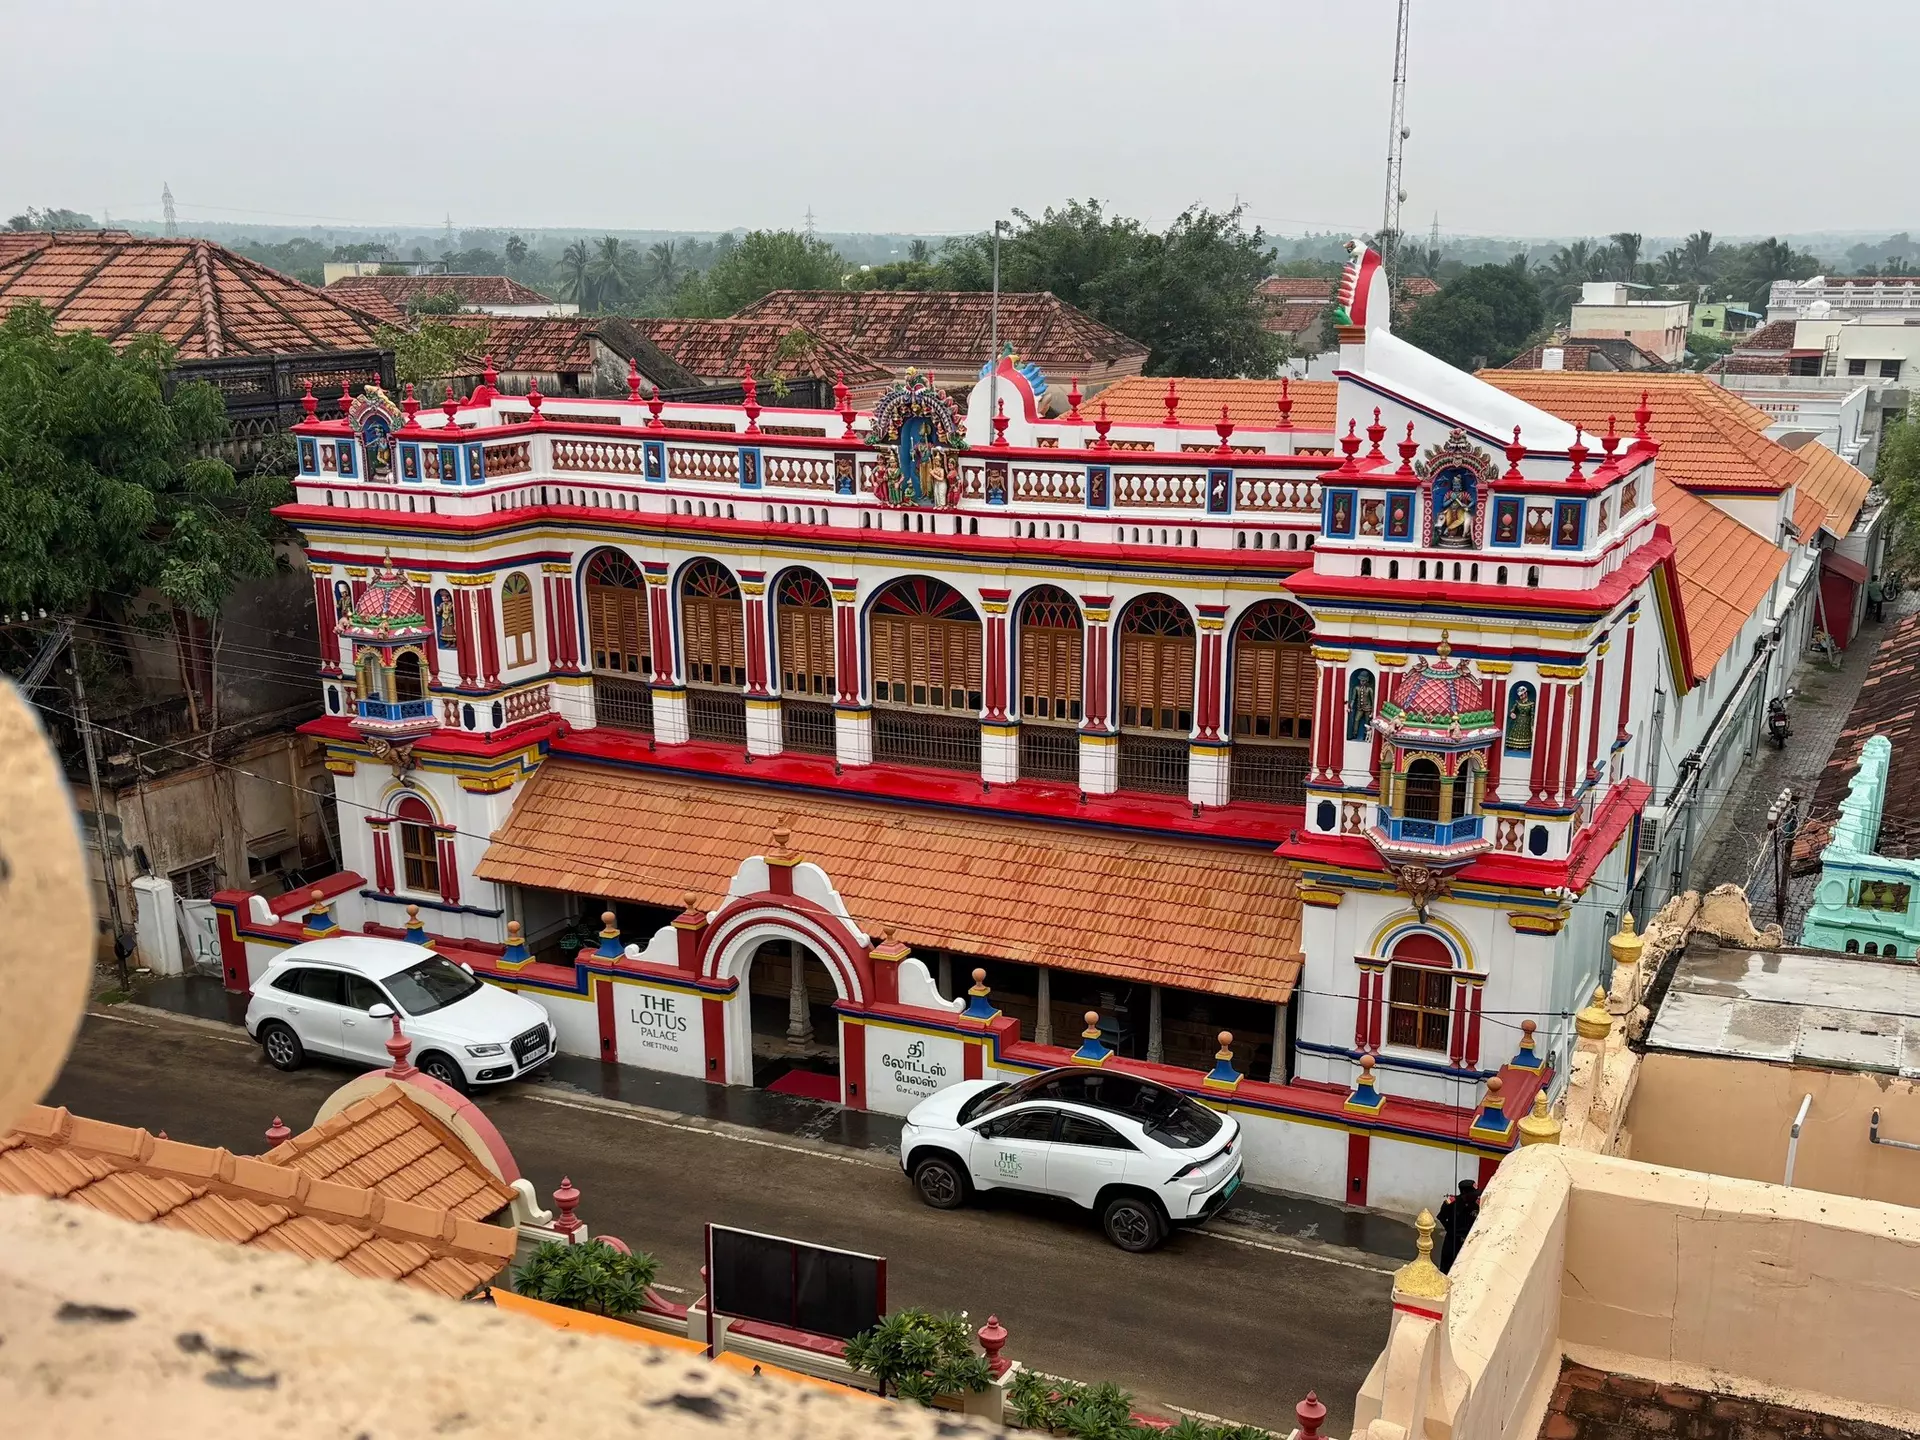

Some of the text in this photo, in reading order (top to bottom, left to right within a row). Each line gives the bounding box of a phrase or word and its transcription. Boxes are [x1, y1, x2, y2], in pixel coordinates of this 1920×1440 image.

[640, 994, 675, 1013] THE
[631, 1009, 687, 1032] LOTUS
[641, 1027, 677, 1042] PALACE
[642, 1040, 679, 1053] CHETTINAD
[907, 1040, 925, 1059] தி
[882, 1054, 947, 1077] லோட்டஸ்
[894, 1070, 938, 1088] பேலஸ்
[994, 1160, 1023, 1171] LOTUS
[999, 1151, 1017, 1163] THE
